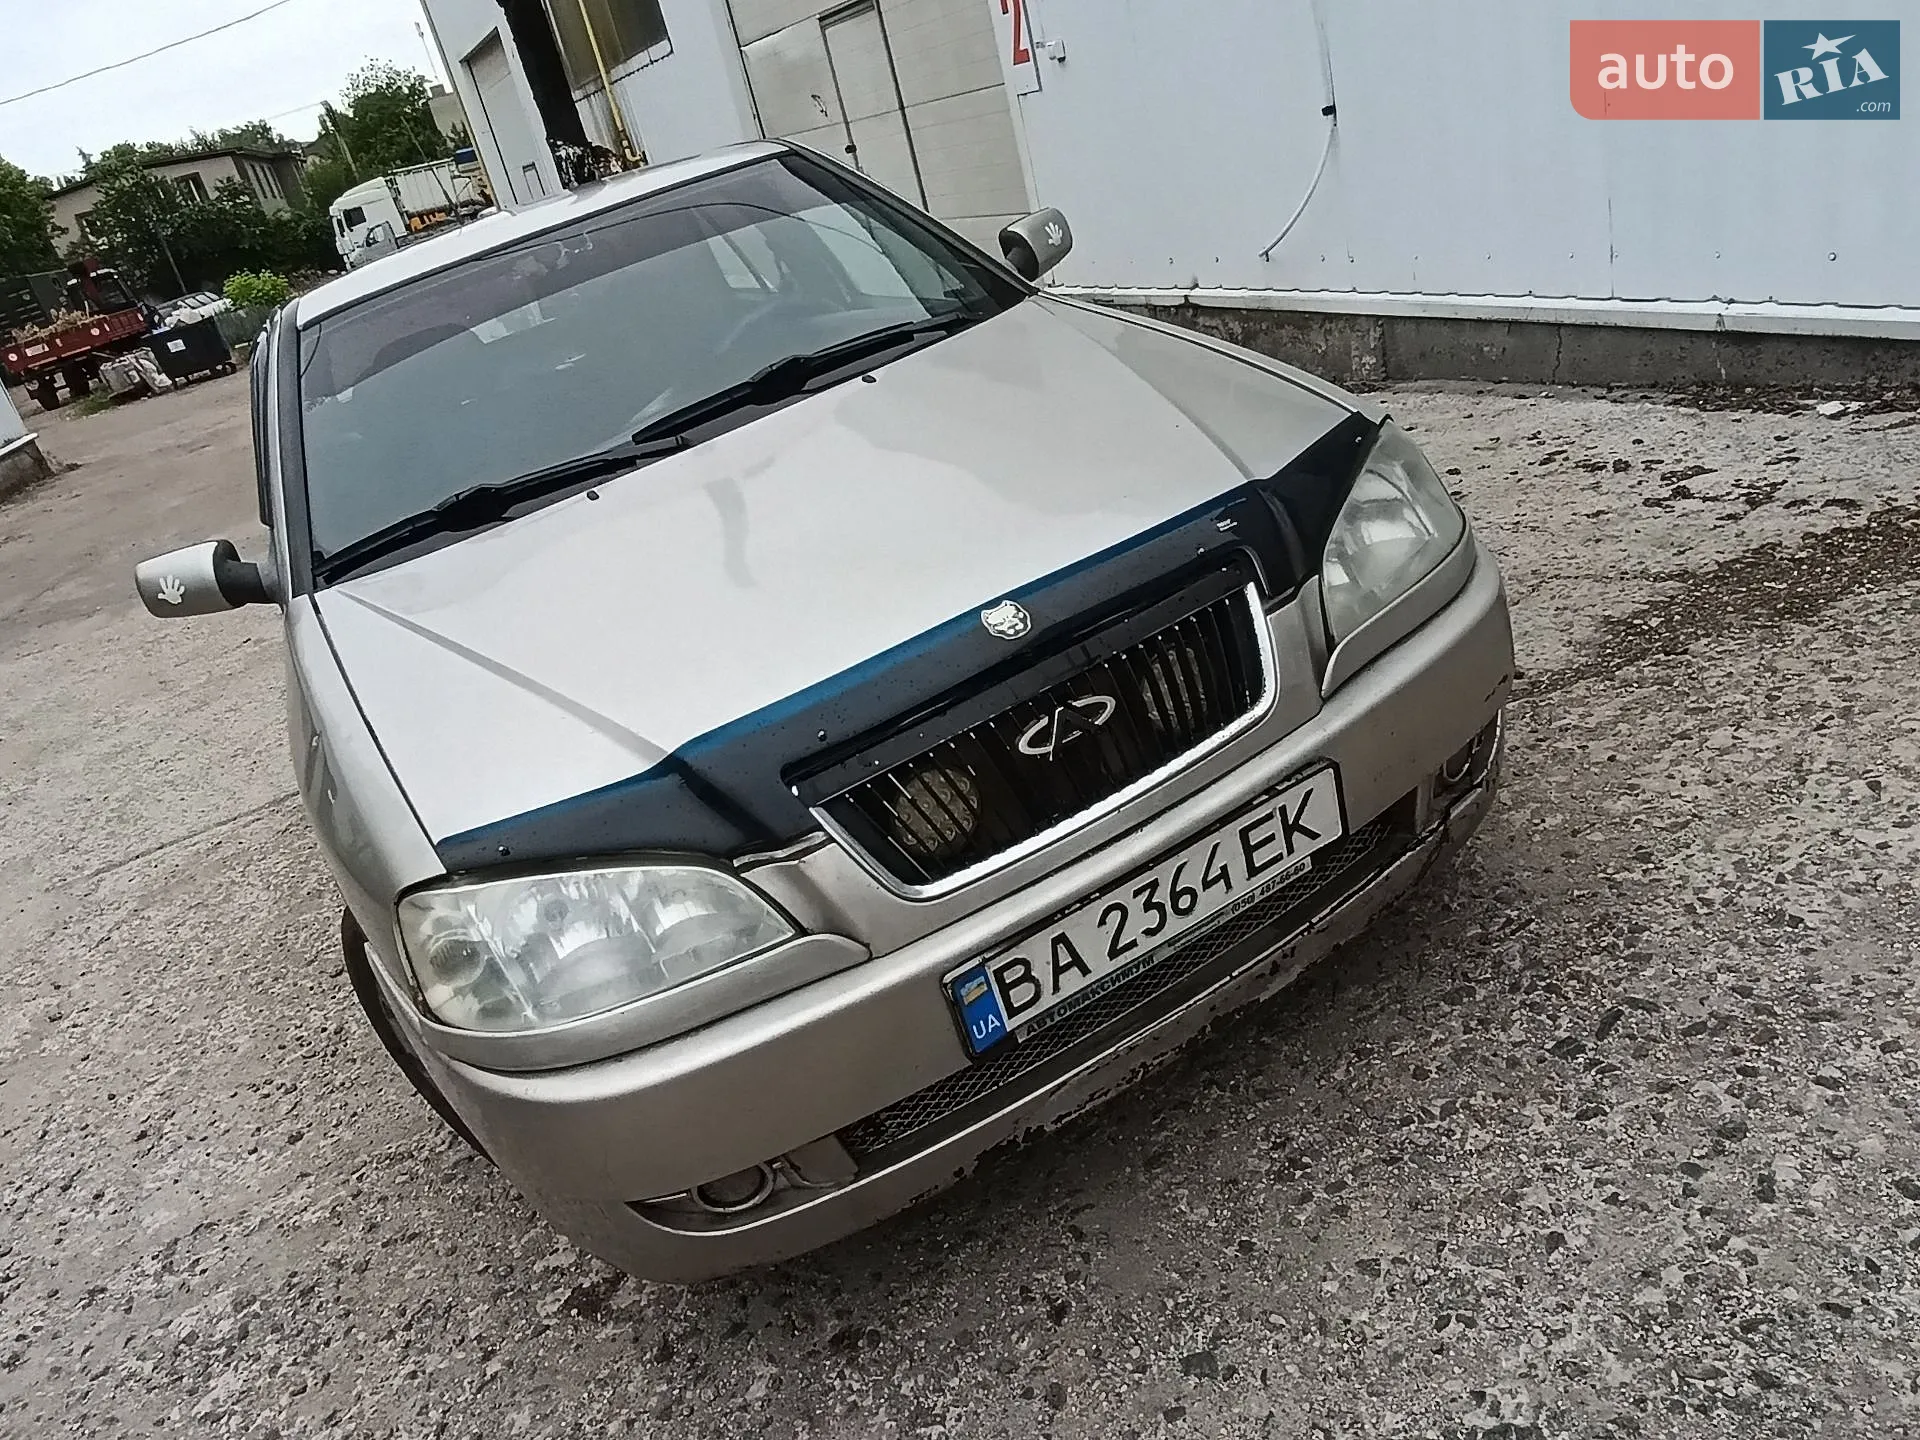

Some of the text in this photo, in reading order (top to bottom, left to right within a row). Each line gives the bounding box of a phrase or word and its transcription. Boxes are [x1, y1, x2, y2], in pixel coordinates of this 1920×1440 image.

[993, 929, 1092, 1021] BA
[1097, 840, 1234, 962] 2364
[1238, 787, 1322, 881] EK
[972, 1013, 1001, 1040] UA
[1024, 953, 1156, 1037] АВТОМАКСИМУМ
